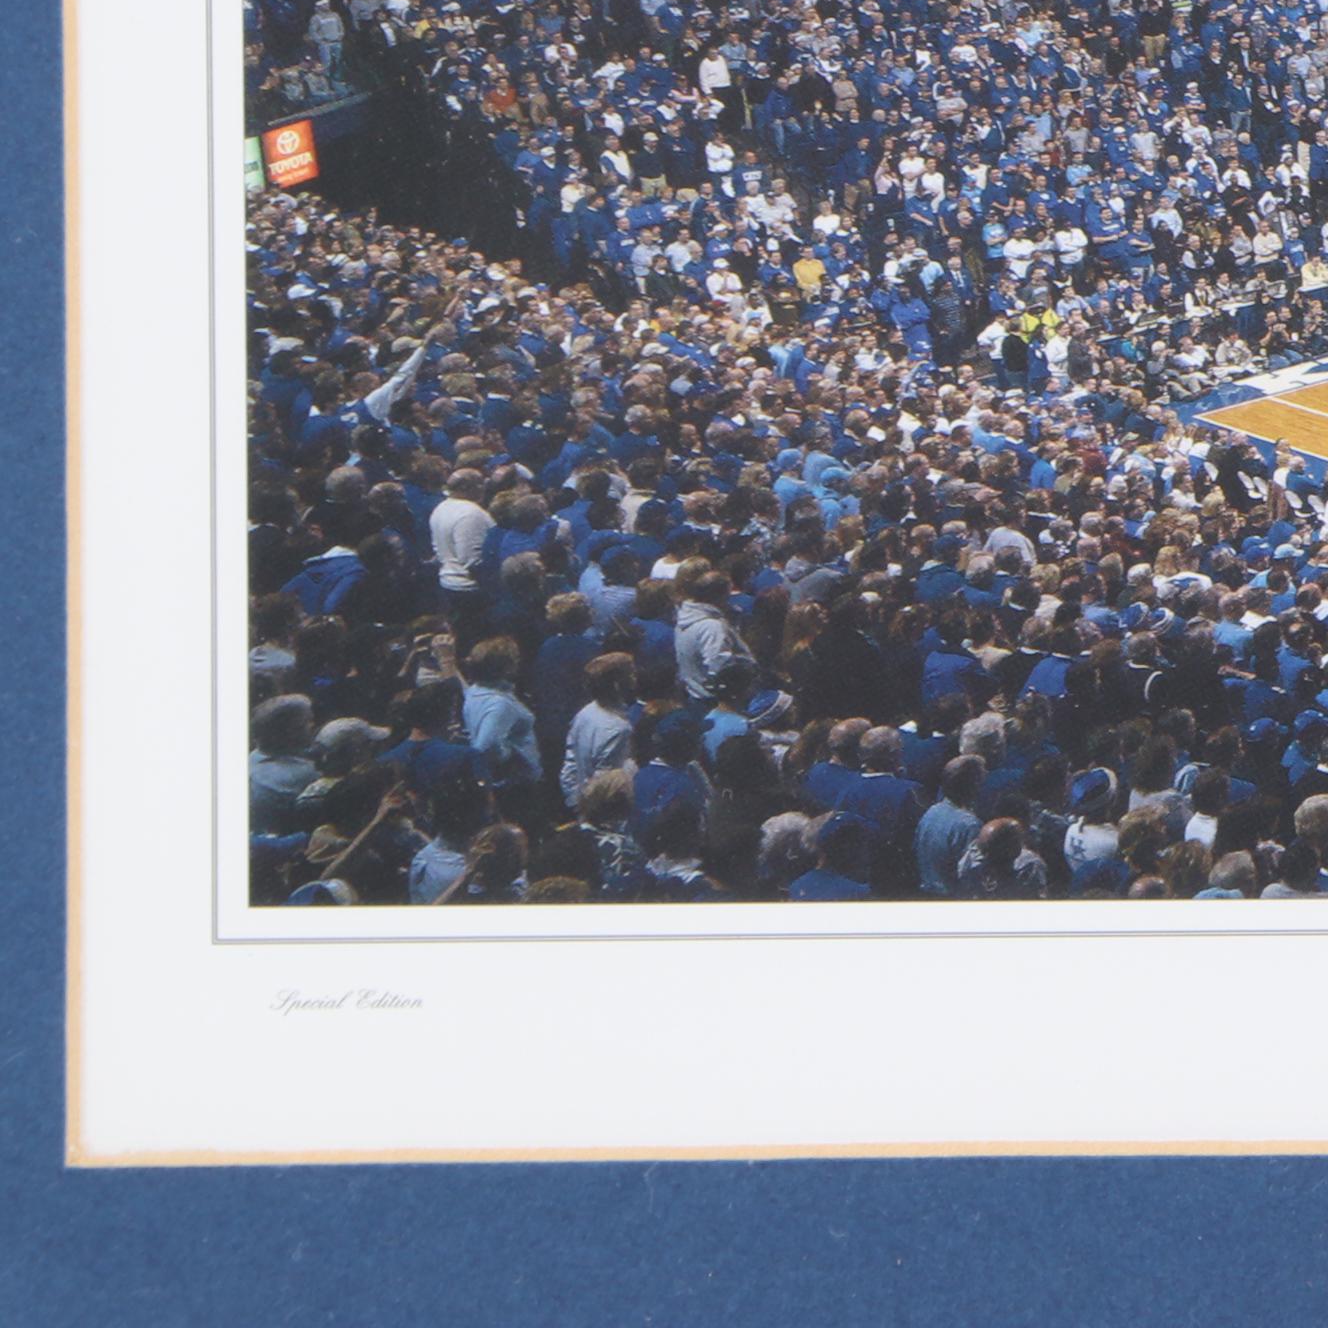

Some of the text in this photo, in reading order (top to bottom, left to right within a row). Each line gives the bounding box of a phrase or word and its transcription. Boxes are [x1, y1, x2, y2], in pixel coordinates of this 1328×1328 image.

[268, 152, 314, 175] TOYOTA
[269, 988, 424, 1017] Special Edition
